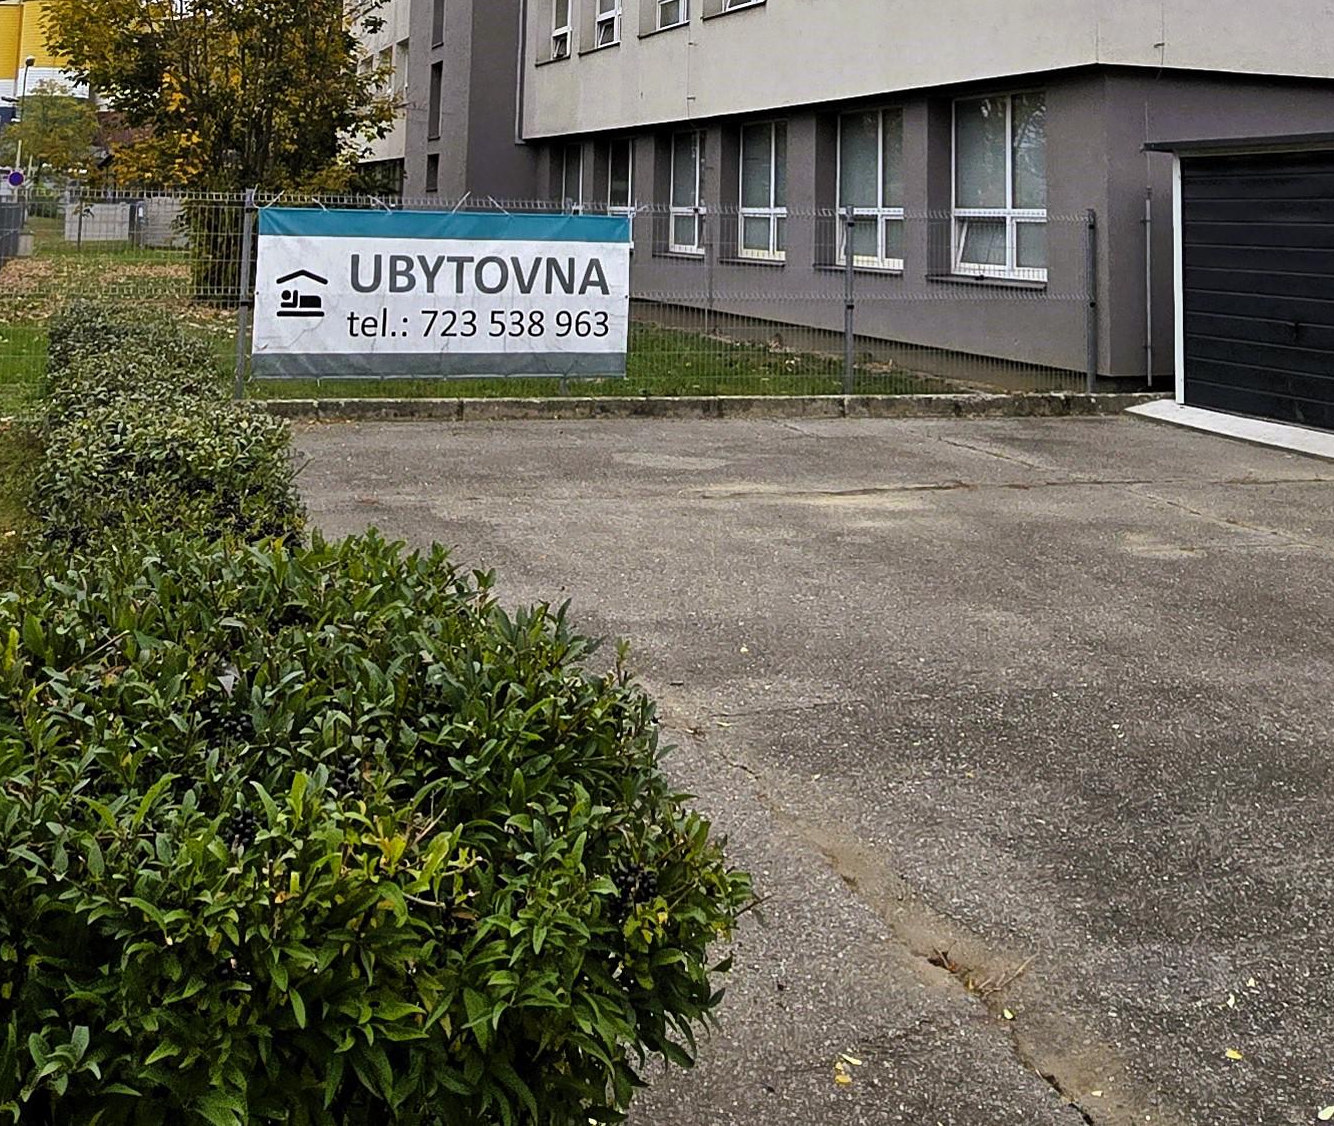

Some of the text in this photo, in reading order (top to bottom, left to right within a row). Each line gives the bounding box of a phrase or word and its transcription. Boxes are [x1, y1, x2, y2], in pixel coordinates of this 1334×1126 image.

[350, 254, 610, 296] UBYTOVNA
[347, 308, 609, 338] tel.: 723 538 963
